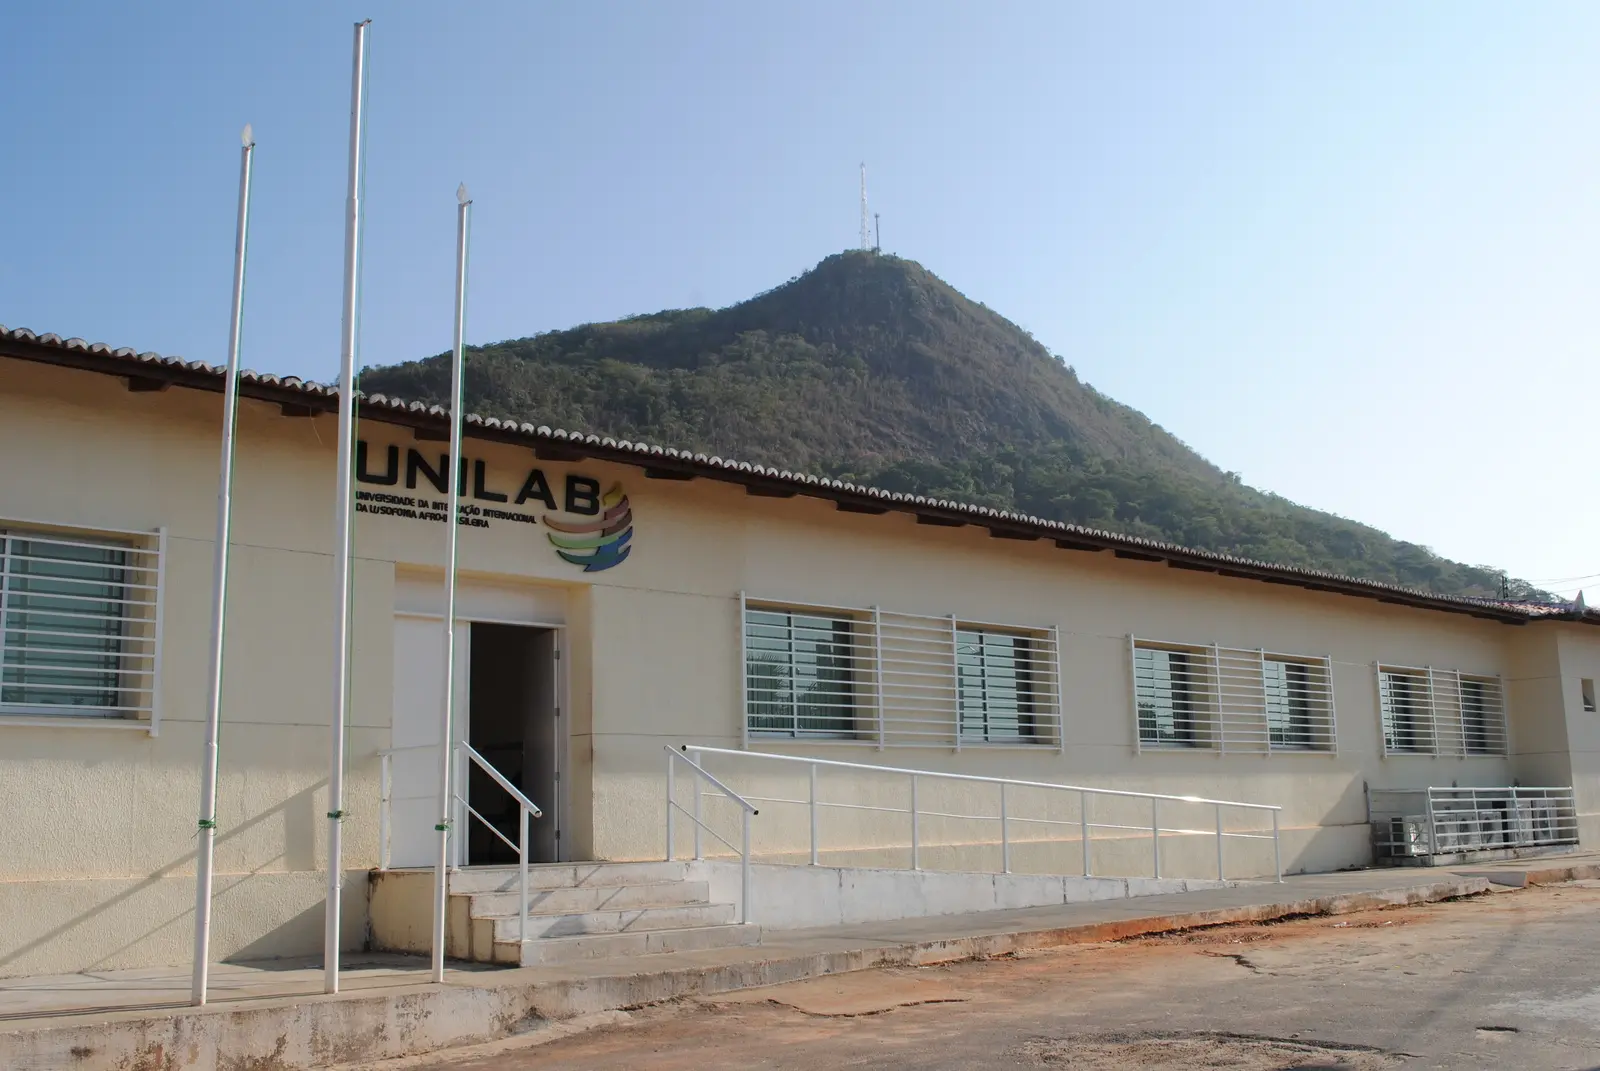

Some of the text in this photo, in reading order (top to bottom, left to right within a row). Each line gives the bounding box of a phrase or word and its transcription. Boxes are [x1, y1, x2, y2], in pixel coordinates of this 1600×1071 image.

[356, 440, 600, 515] UNILAB
[355, 491, 537, 524] UNIVERSIDADE DA INTEAÇÃO INTERNACIONAL
[355, 503, 490, 528] DA LUSOFONIA AFRO-BSILEIRA
